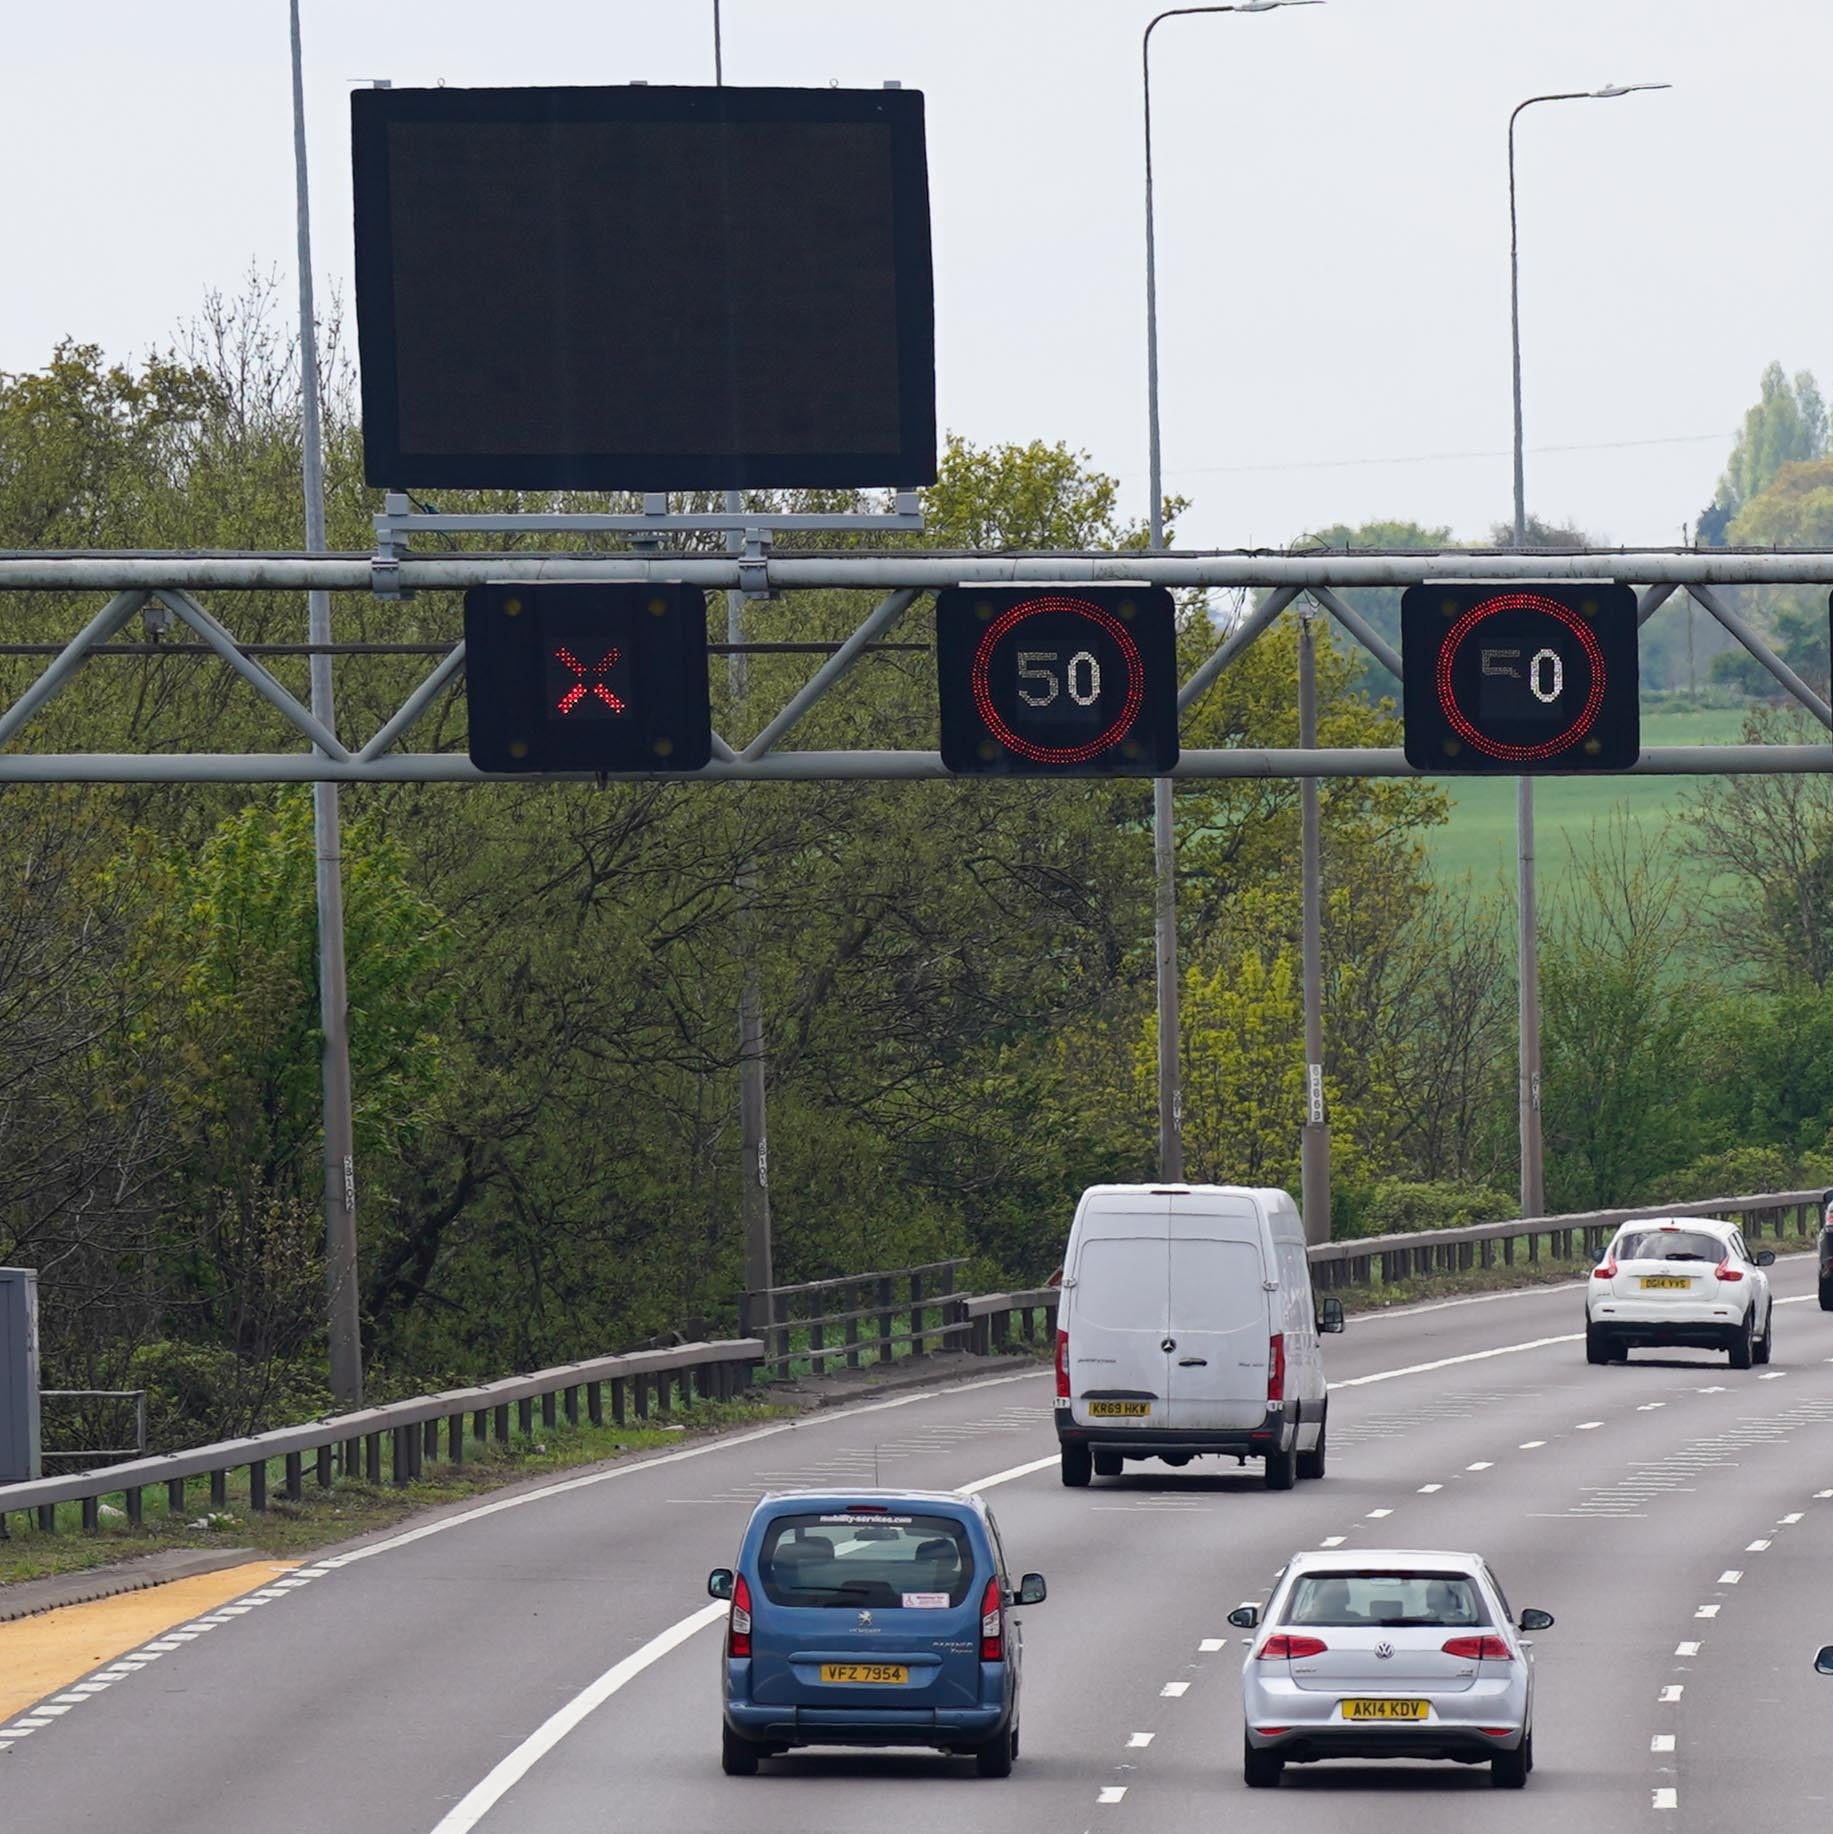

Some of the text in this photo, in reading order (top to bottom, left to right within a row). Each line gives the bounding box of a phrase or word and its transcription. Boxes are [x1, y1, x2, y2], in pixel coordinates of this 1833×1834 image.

[1018, 652, 1100, 706] 50
[1093, 1401, 1146, 1412] KR69 HKW
[829, 1666, 902, 1682] VFZ 7954
[1353, 1701, 1420, 1716] AK14 KDV
